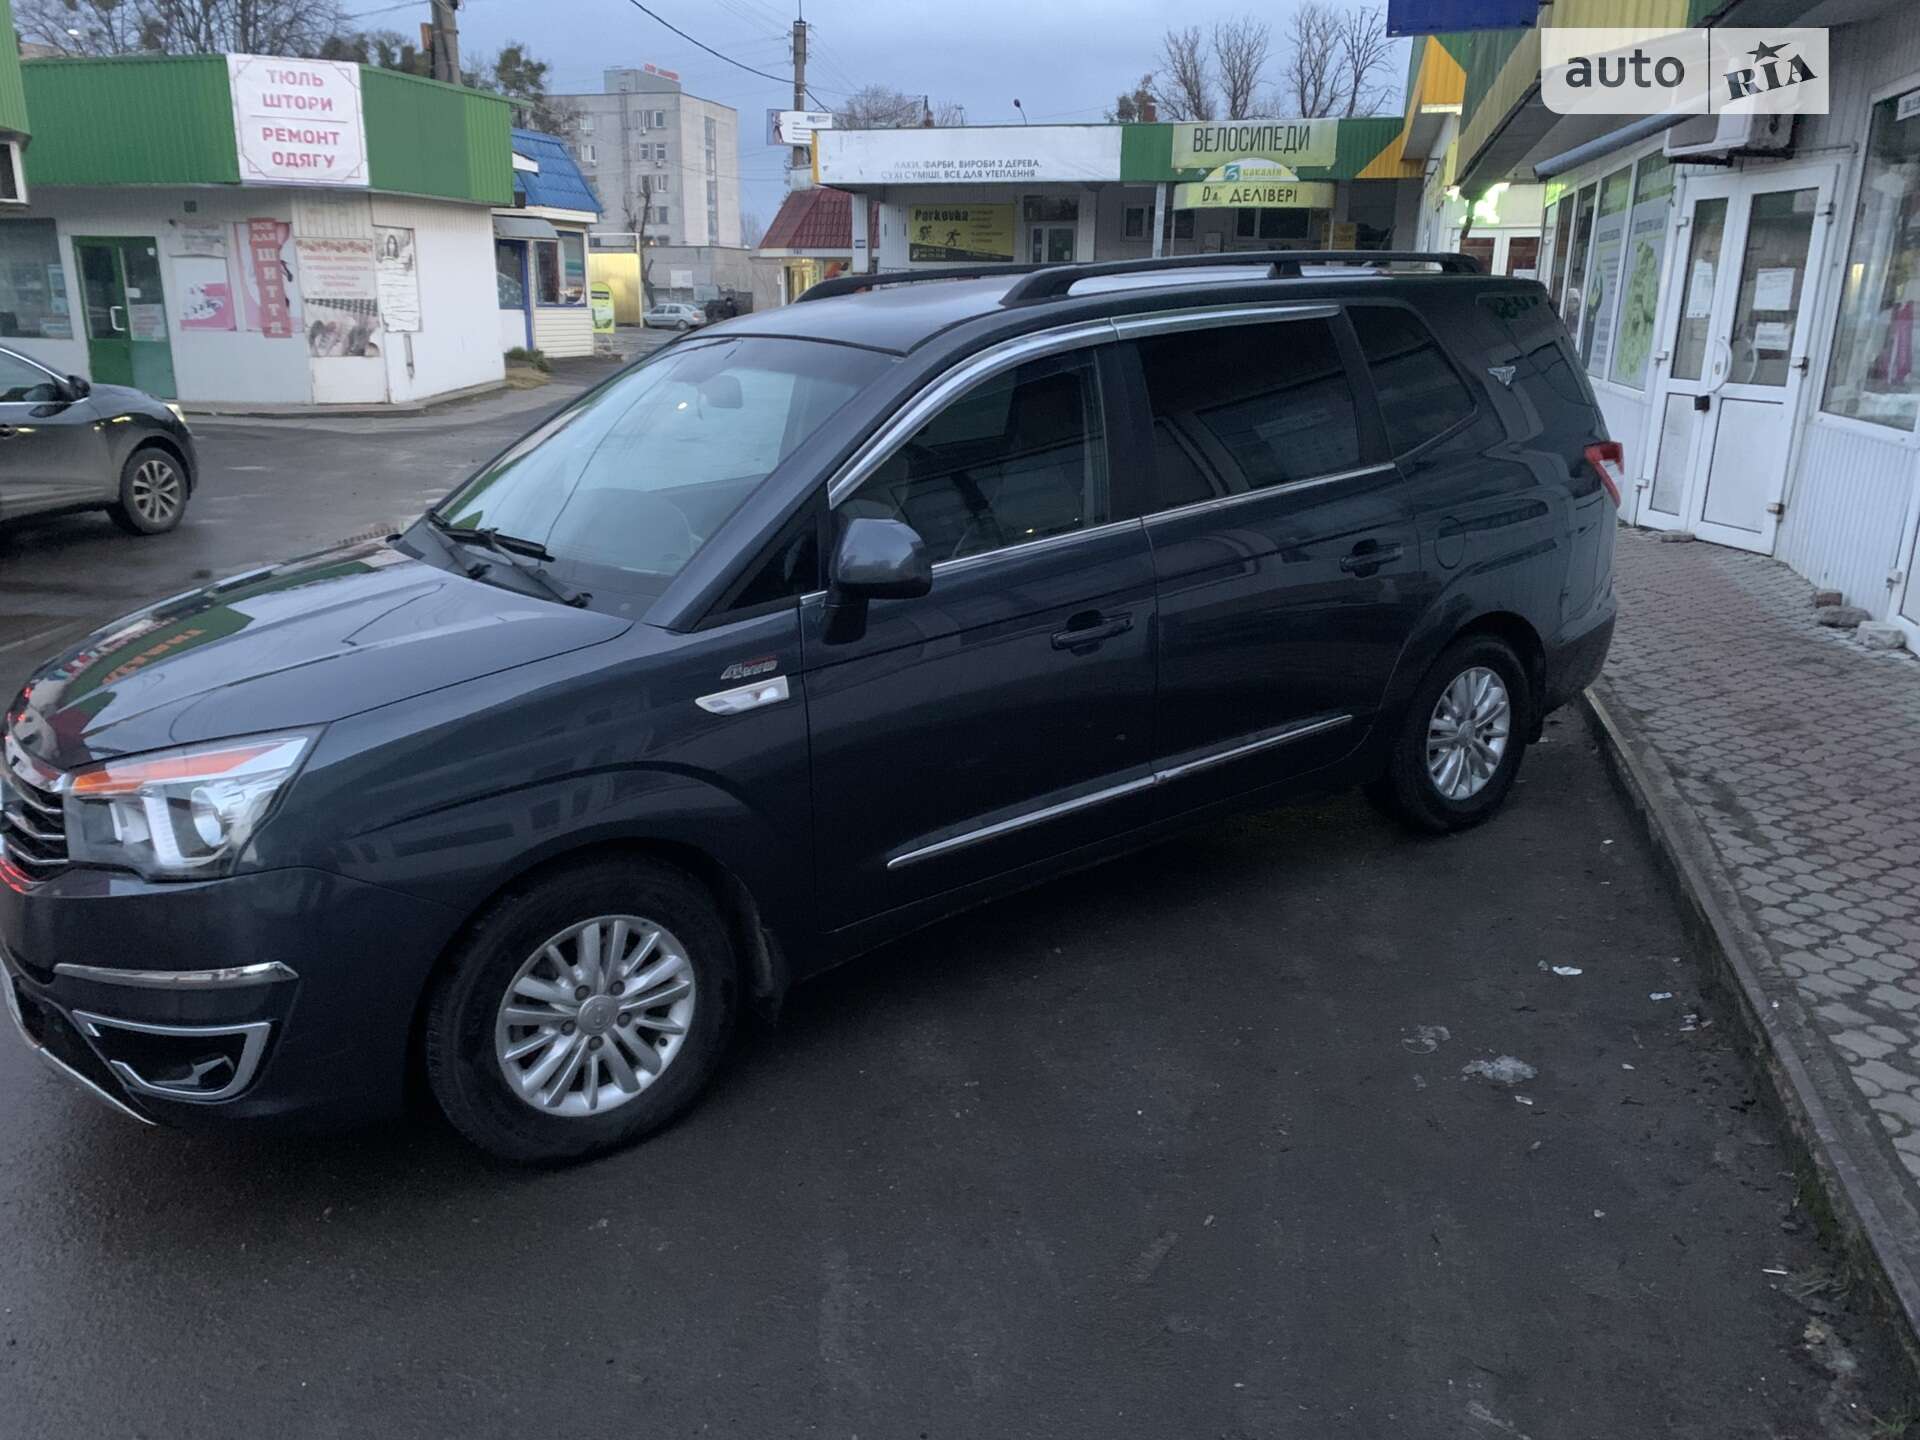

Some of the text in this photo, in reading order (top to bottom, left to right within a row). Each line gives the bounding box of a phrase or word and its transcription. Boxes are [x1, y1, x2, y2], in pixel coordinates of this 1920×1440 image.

[266, 69, 324, 87] ТЮЛЬ
[262, 93, 333, 111] ШТОРИ
[262, 127, 340, 145] РЕМОНТ
[1193, 125, 1310, 154] ВЕЛОСИПЕДИ
[272, 151, 335, 168] ОДЯГУ
[1229, 188, 1297, 204] ДЕЛІВЕРІ
